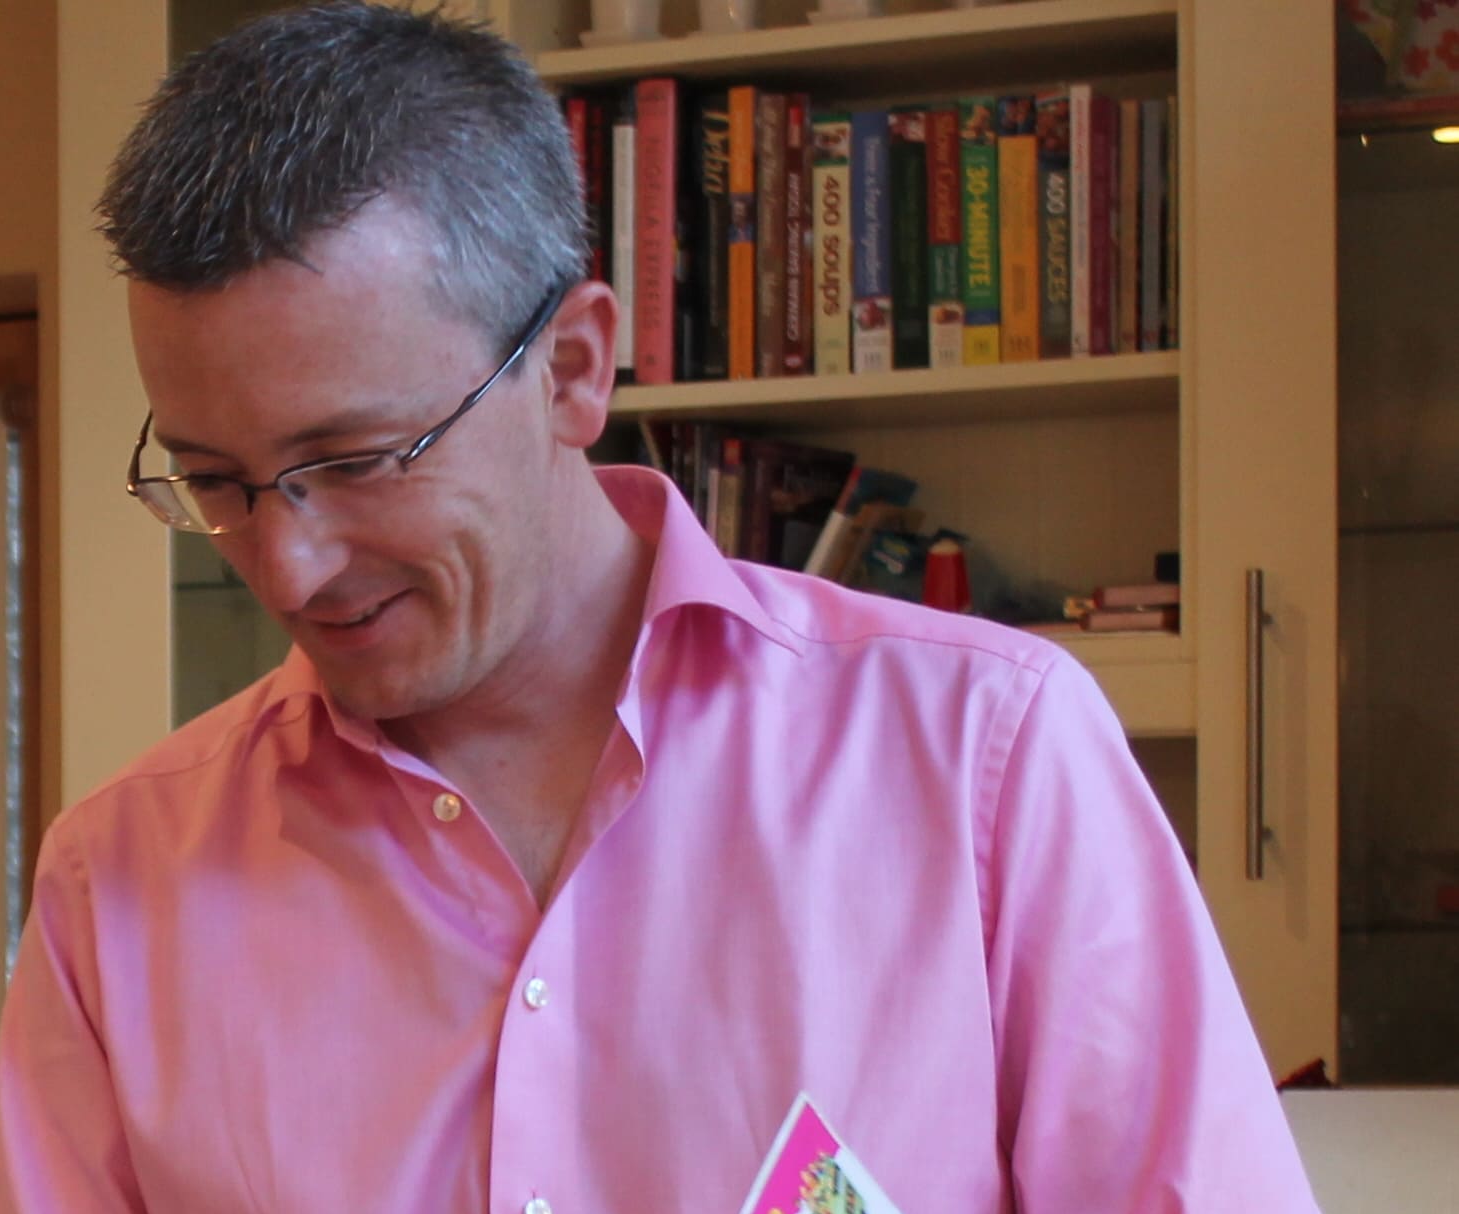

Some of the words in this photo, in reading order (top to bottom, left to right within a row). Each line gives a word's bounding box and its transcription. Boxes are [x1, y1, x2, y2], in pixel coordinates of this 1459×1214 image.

[934, 113, 957, 163] Slow
[821, 176, 841, 226] 400
[933, 168, 958, 241] Cooker
[965, 165, 991, 288] 30-MINUTE
[1046, 172, 1066, 214] 400
[820, 235, 843, 317] soups
[1046, 219, 1067, 304] SAUCES
